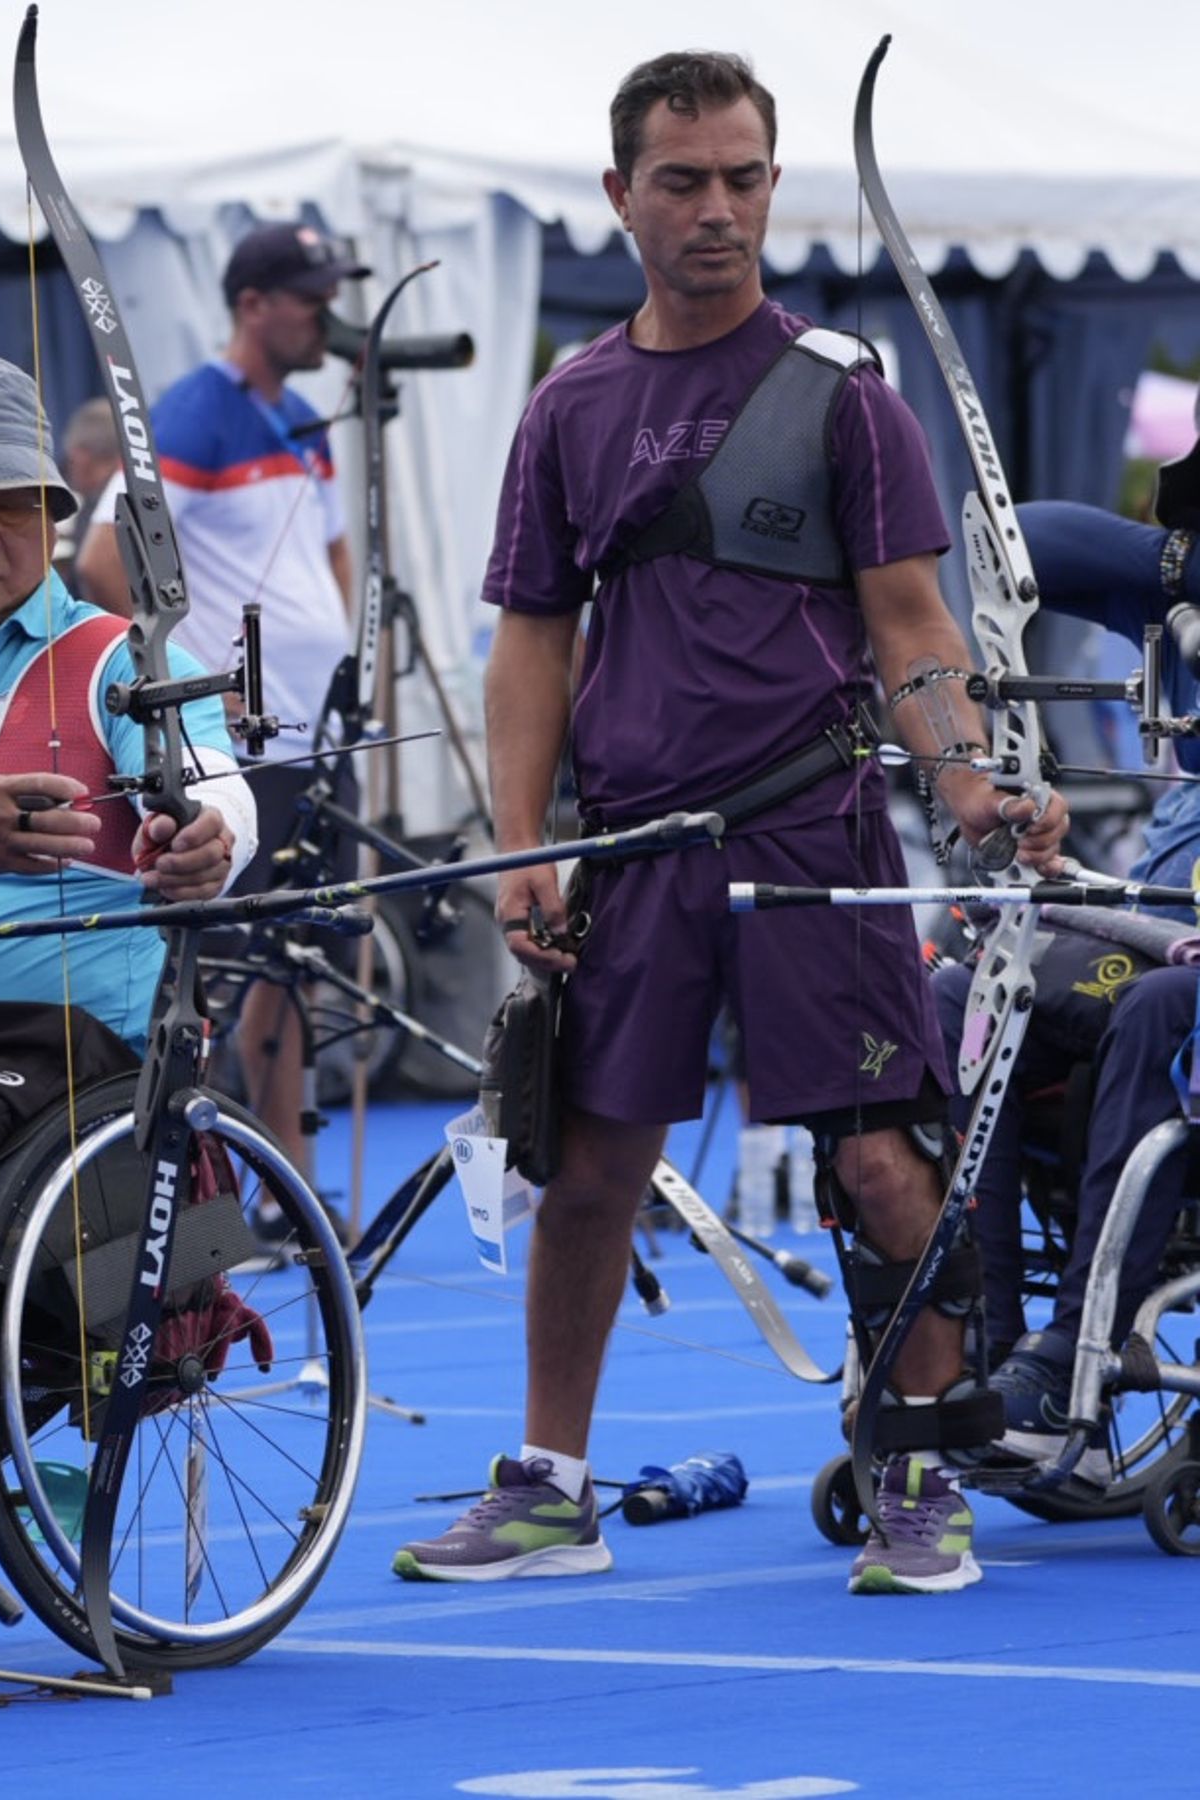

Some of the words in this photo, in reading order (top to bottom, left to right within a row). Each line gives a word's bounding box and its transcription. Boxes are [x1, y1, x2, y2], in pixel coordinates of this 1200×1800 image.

[106, 354, 158, 483] HOYT
[629, 419, 730, 468] AZE
[953, 376, 1001, 482] HOYT
[140, 1159, 179, 1299] HOYT
